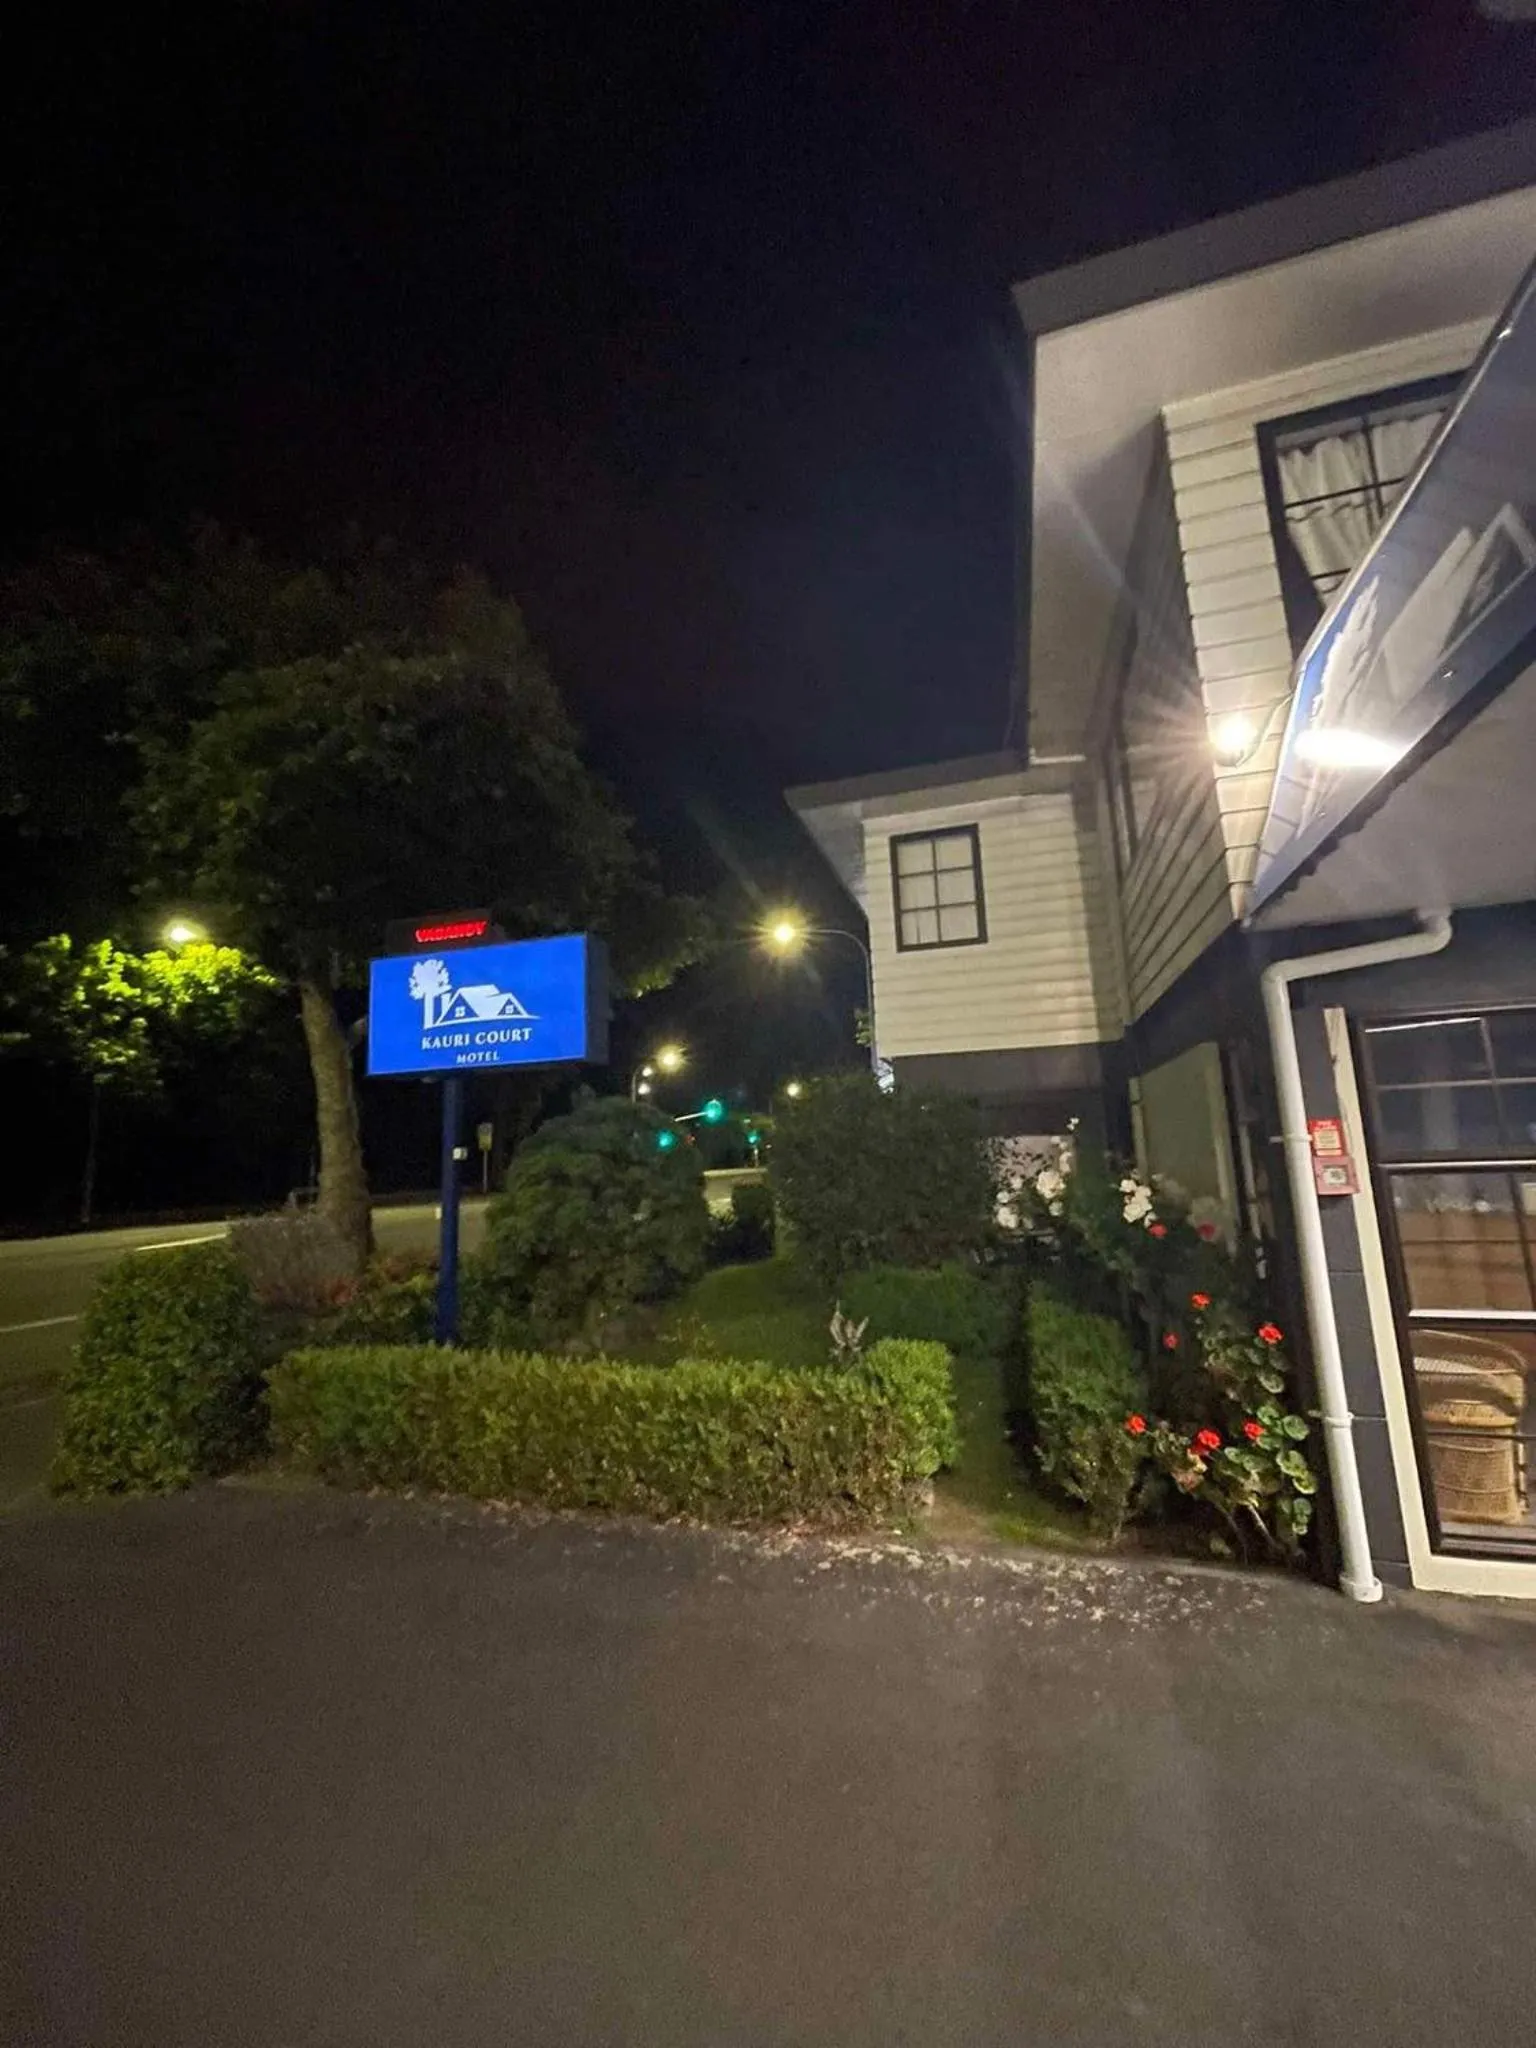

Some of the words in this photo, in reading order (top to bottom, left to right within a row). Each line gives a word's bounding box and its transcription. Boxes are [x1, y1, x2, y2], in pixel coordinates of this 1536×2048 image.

[421, 1033, 470, 1050] KAURI
[475, 1027, 532, 1045] COURT
[456, 1051, 500, 1064] MOTEL
